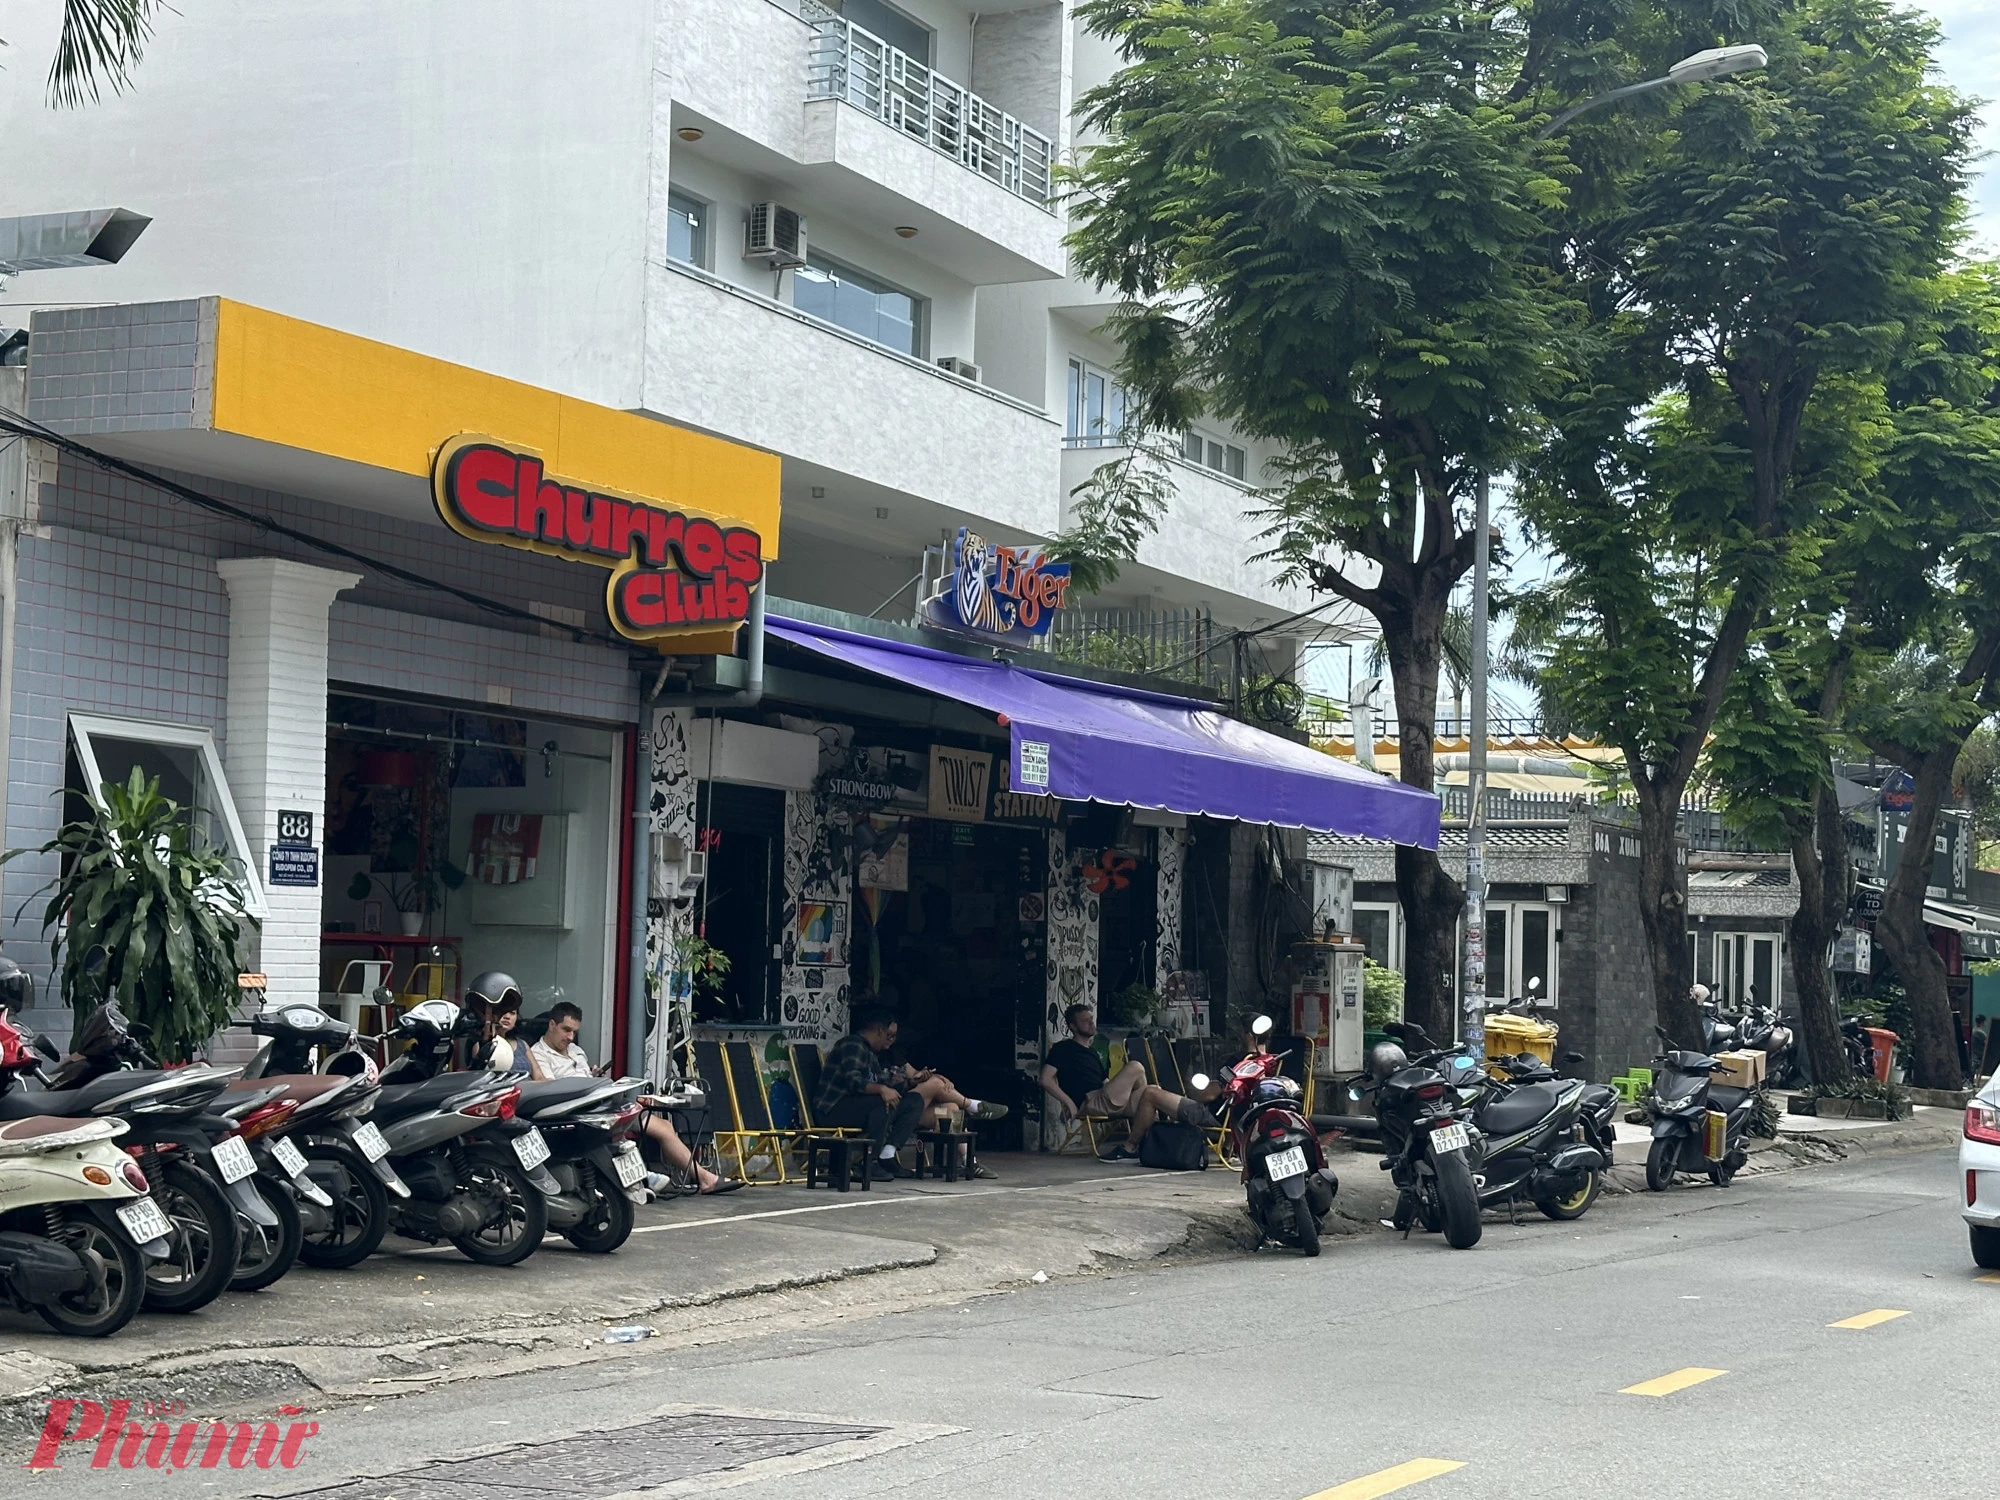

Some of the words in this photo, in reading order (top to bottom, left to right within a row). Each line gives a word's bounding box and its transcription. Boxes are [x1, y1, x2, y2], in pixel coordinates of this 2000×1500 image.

[455, 447, 761, 584] Churros
[622, 565, 749, 628] Club
[994, 544, 1071, 628] Tiger
[829, 778, 893, 800] STRONGBOW
[993, 791, 1062, 824] STATION
[281, 814, 310, 838] 88
[1594, 831, 1610, 854] 86A
[1865, 900, 1880, 908] TD
[798, 1008, 821, 1024] GOOD
[788, 1025, 820, 1040] MORNING
[219, 1142, 244, 1163] 62-K1
[124, 1203, 155, 1224] 63-B9
